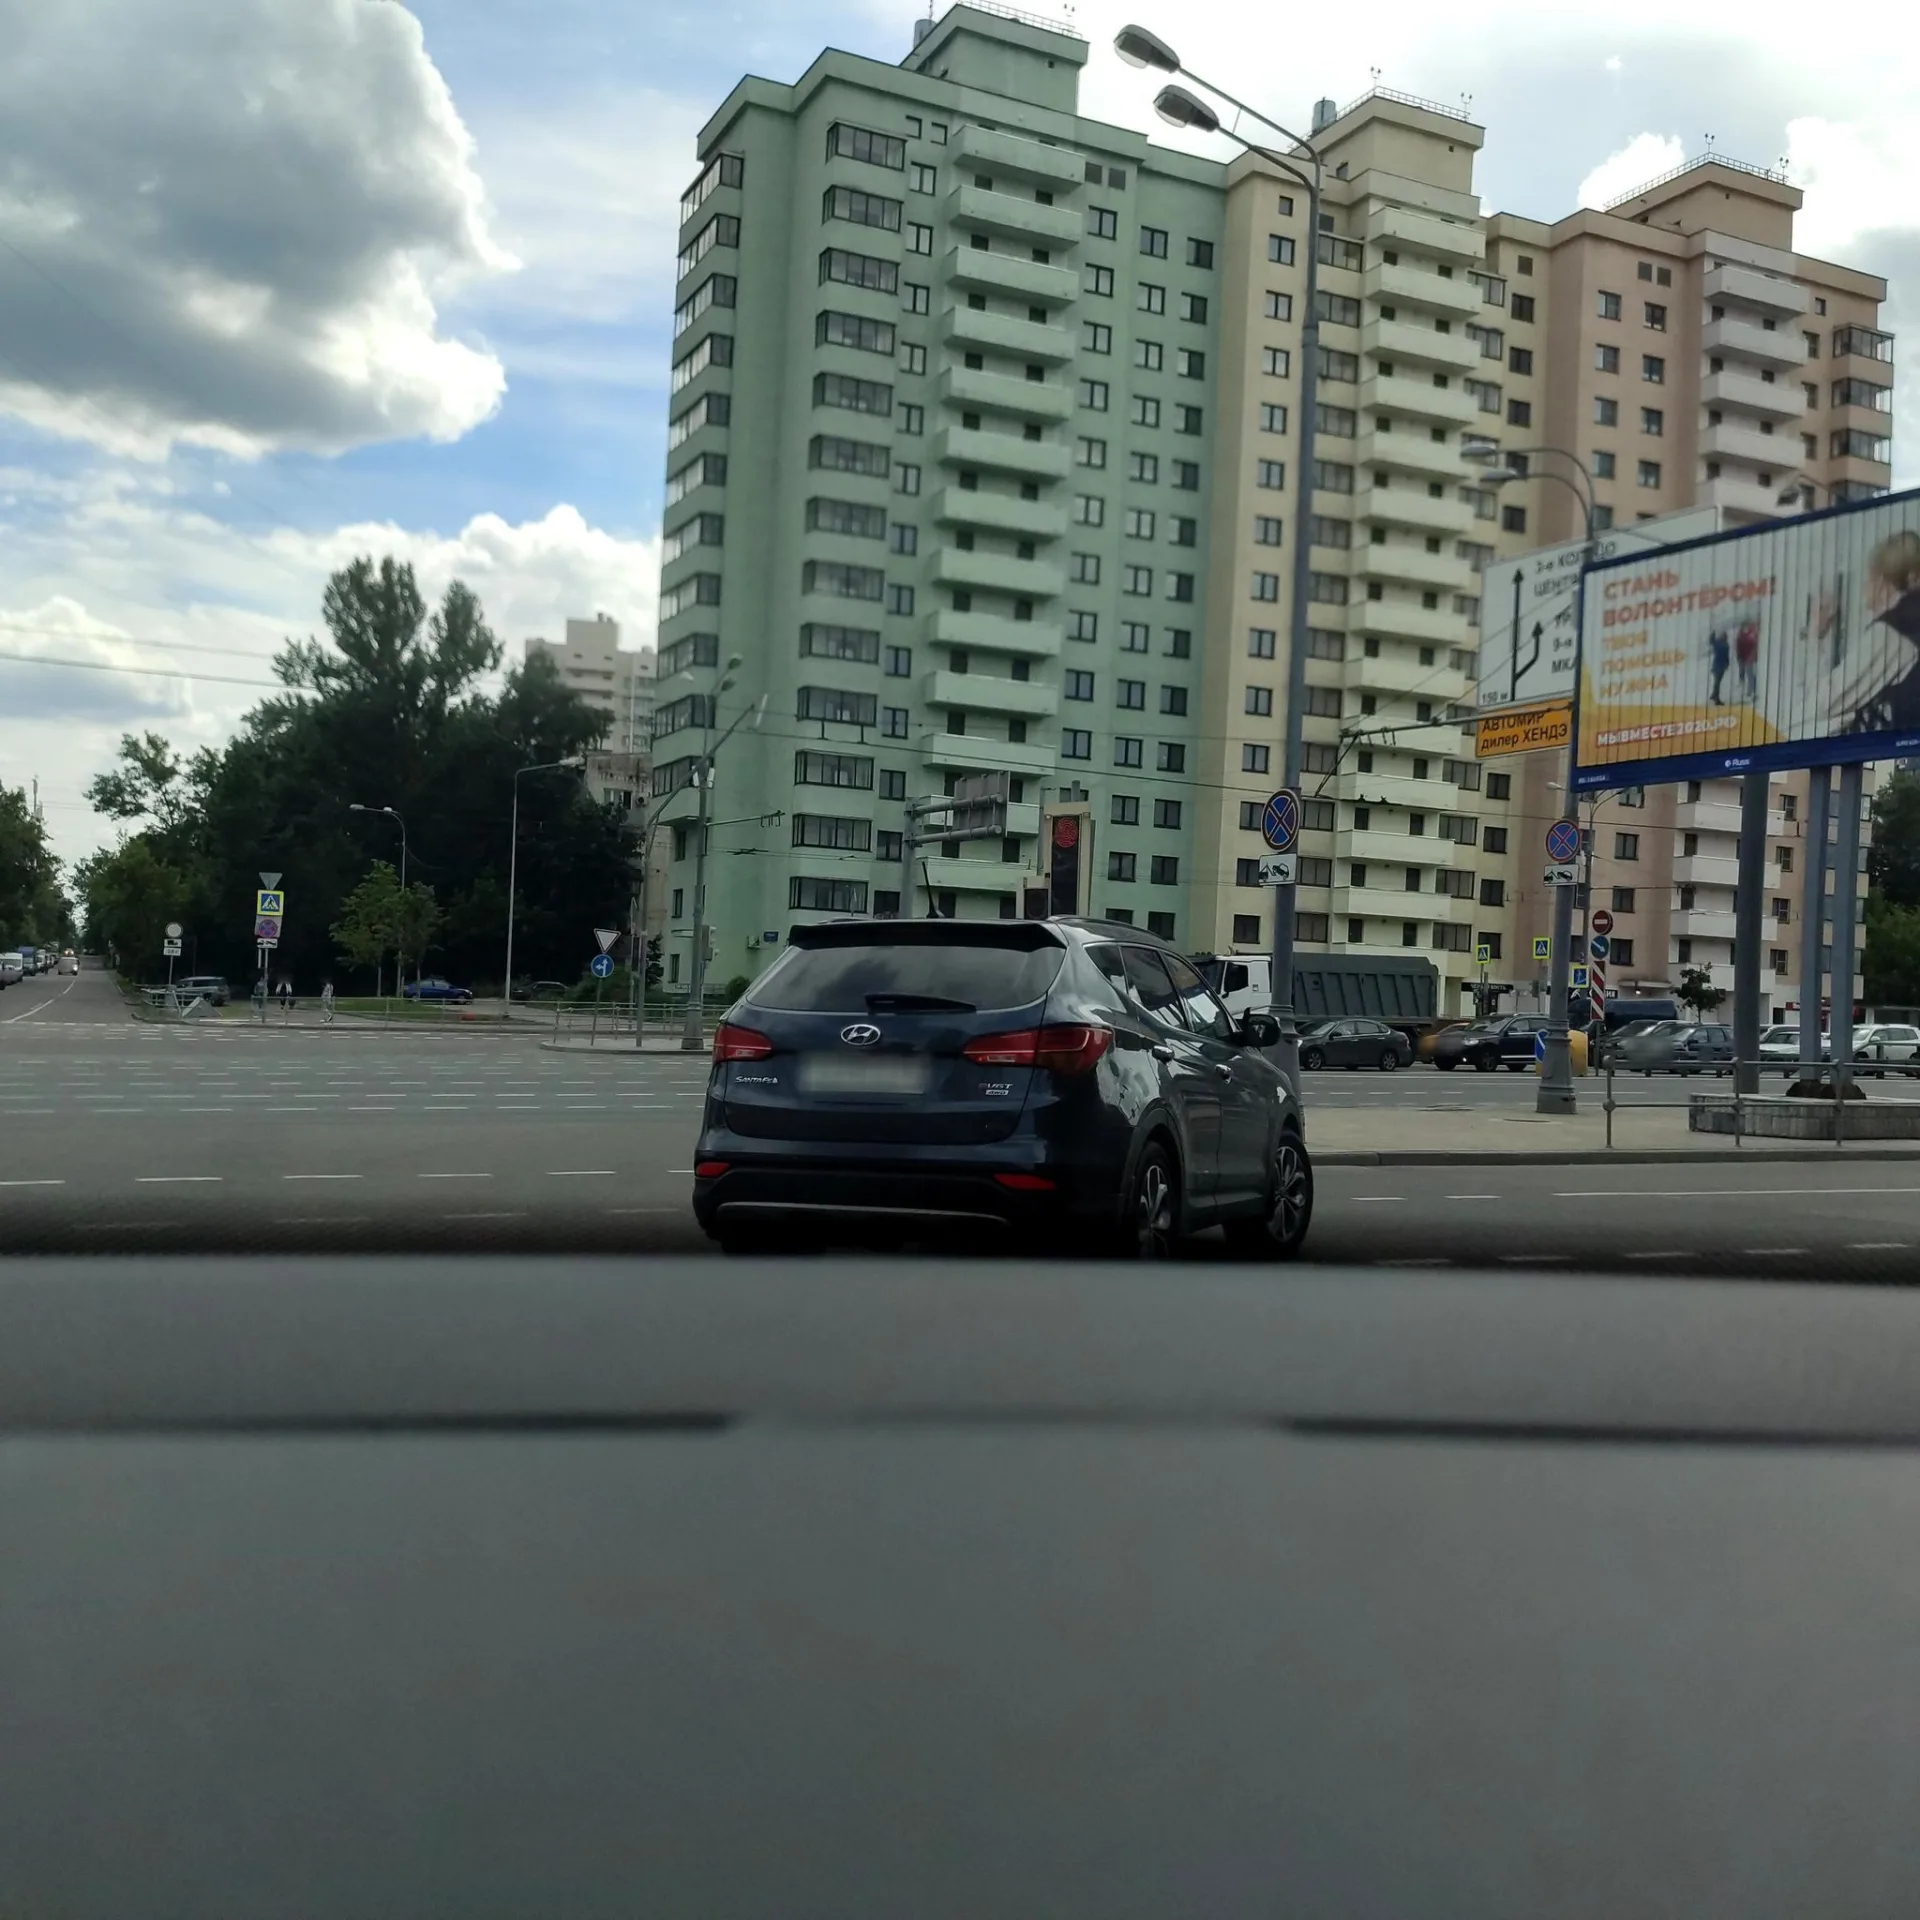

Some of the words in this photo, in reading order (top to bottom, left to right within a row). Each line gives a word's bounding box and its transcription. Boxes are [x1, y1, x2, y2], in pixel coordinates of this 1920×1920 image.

[1557, 541, 1616, 567] КОЛЦО
[1603, 569, 1680, 599] СТАНЬ
[1602, 647, 1687, 675] ПОМОЩЬ
[1600, 674, 1669, 697] НУЖНА
[1482, 711, 1546, 733] АВТОМИР
[1481, 733, 1519, 751] дилер
[1522, 723, 1568, 743] ХЕНДЭ
